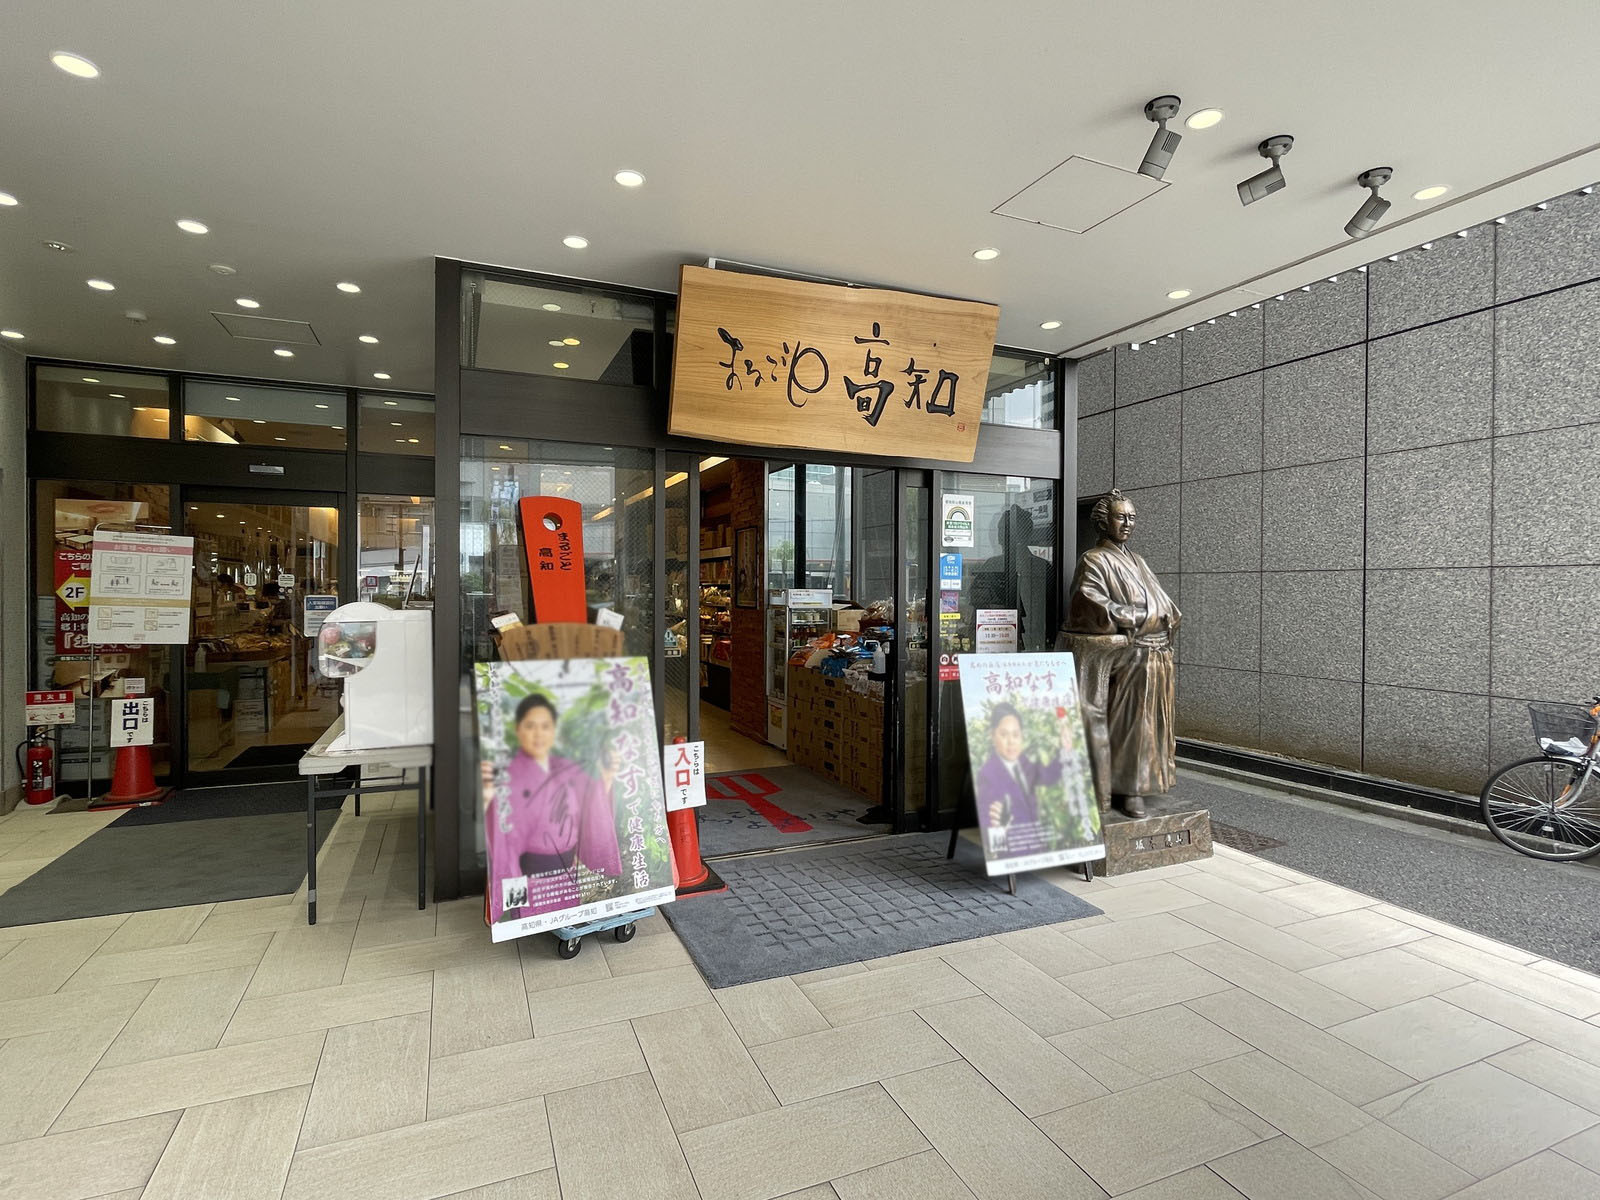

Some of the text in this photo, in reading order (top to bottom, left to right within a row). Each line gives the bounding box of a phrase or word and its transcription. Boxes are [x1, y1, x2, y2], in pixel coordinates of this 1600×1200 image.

[538, 547, 555, 572] 高知
[557, 532, 573, 571] まるごと
[65, 587, 85, 599] 2F
[983, 670, 1057, 695] 高知なす
[142, 700, 150, 723] こちらは
[692, 745, 700, 776] こちらは
